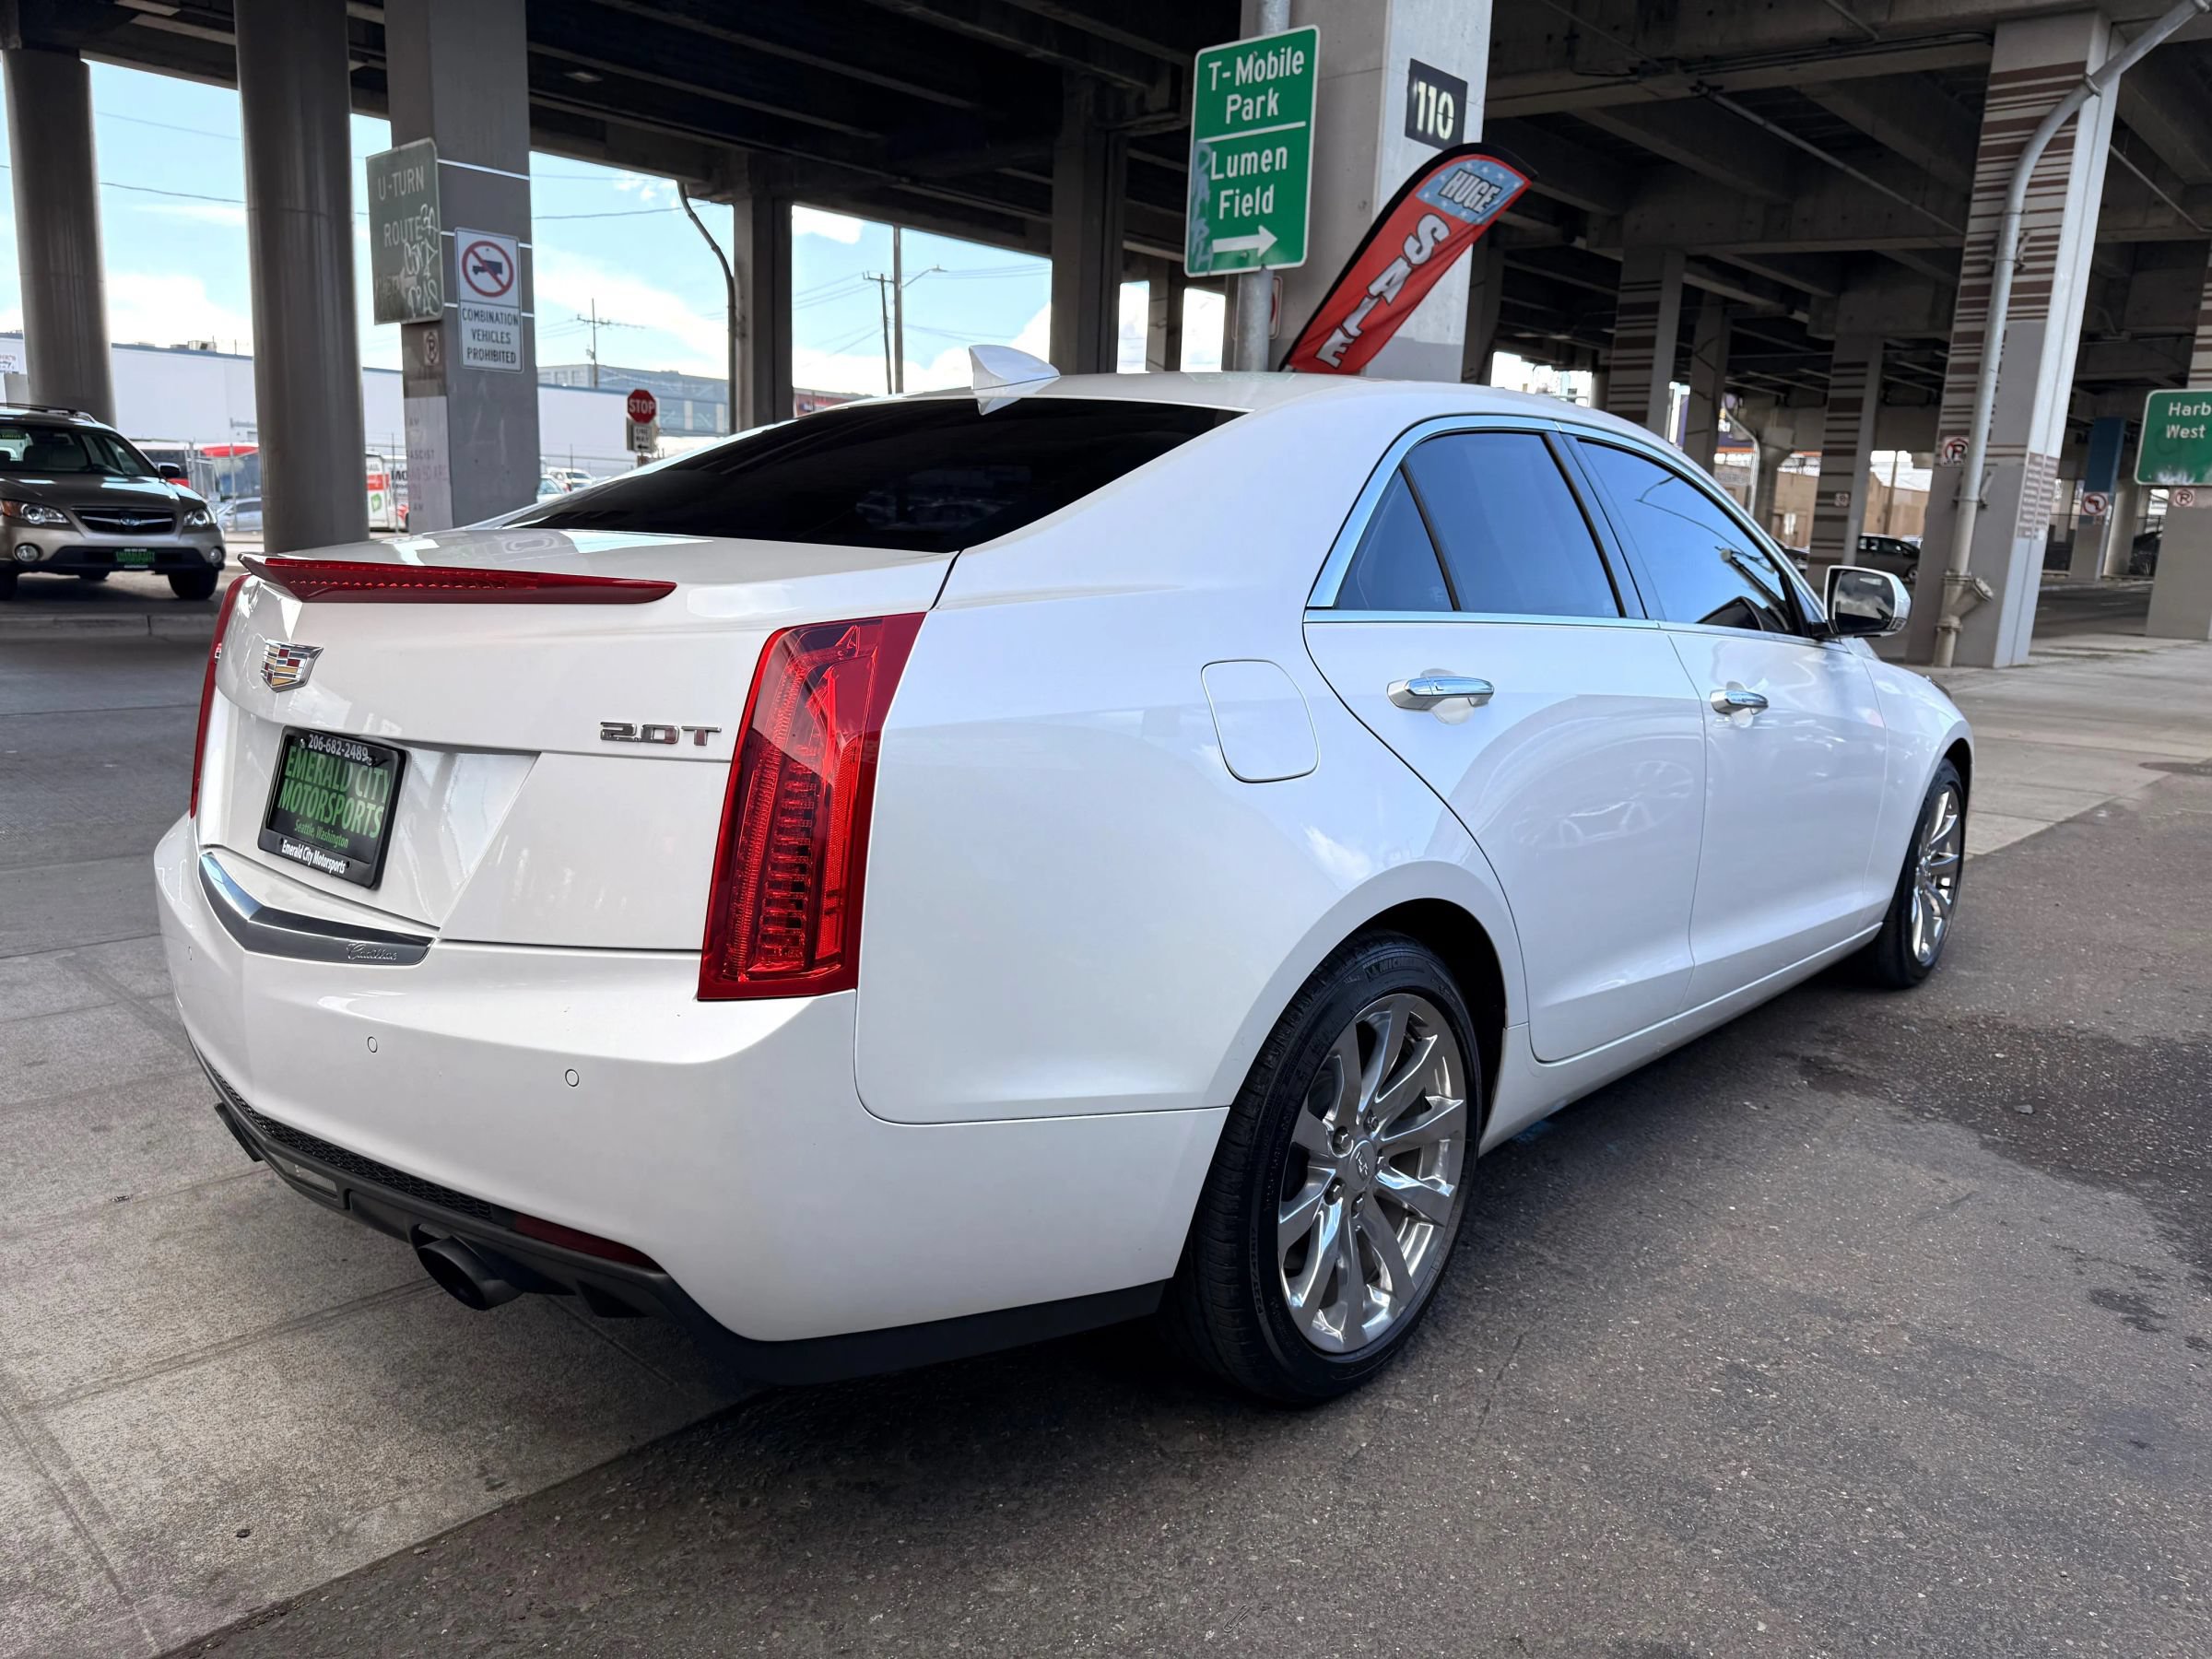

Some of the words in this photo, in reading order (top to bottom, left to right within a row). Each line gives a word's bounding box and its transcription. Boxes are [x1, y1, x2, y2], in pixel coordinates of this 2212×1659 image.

[1208, 45, 1304, 91] T-Mobile
[1226, 88, 1279, 124] Park
[1416, 81, 1454, 140] 110
[1210, 146, 1288, 181] Lumen
[378, 166, 424, 201] U-TURN
[1218, 183, 1275, 219] Field
[1438, 168, 1502, 214] HUGE
[1315, 213, 1452, 369] SALE
[462, 308, 519, 325] COMBINATION
[471, 328, 511, 345] VEHICLES
[466, 347, 516, 364] PROHIBITED
[629, 399, 655, 415] STOP
[2168, 401, 2212, 417] Harb
[2166, 424, 2206, 439] West
[308, 734, 370, 762] 206-682-2489
[600, 722, 722, 747] 2.0T
[285, 745, 354, 794] EMERALD
[355, 764, 392, 804] CITY
[277, 778, 384, 838] MOTORSPORTS
[294, 818, 316, 839] Seattle,
[315, 826, 348, 849] Washington
[281, 839, 304, 860] Emerald
[302, 846, 315, 866] City
[312, 852, 346, 875] Motorsports
